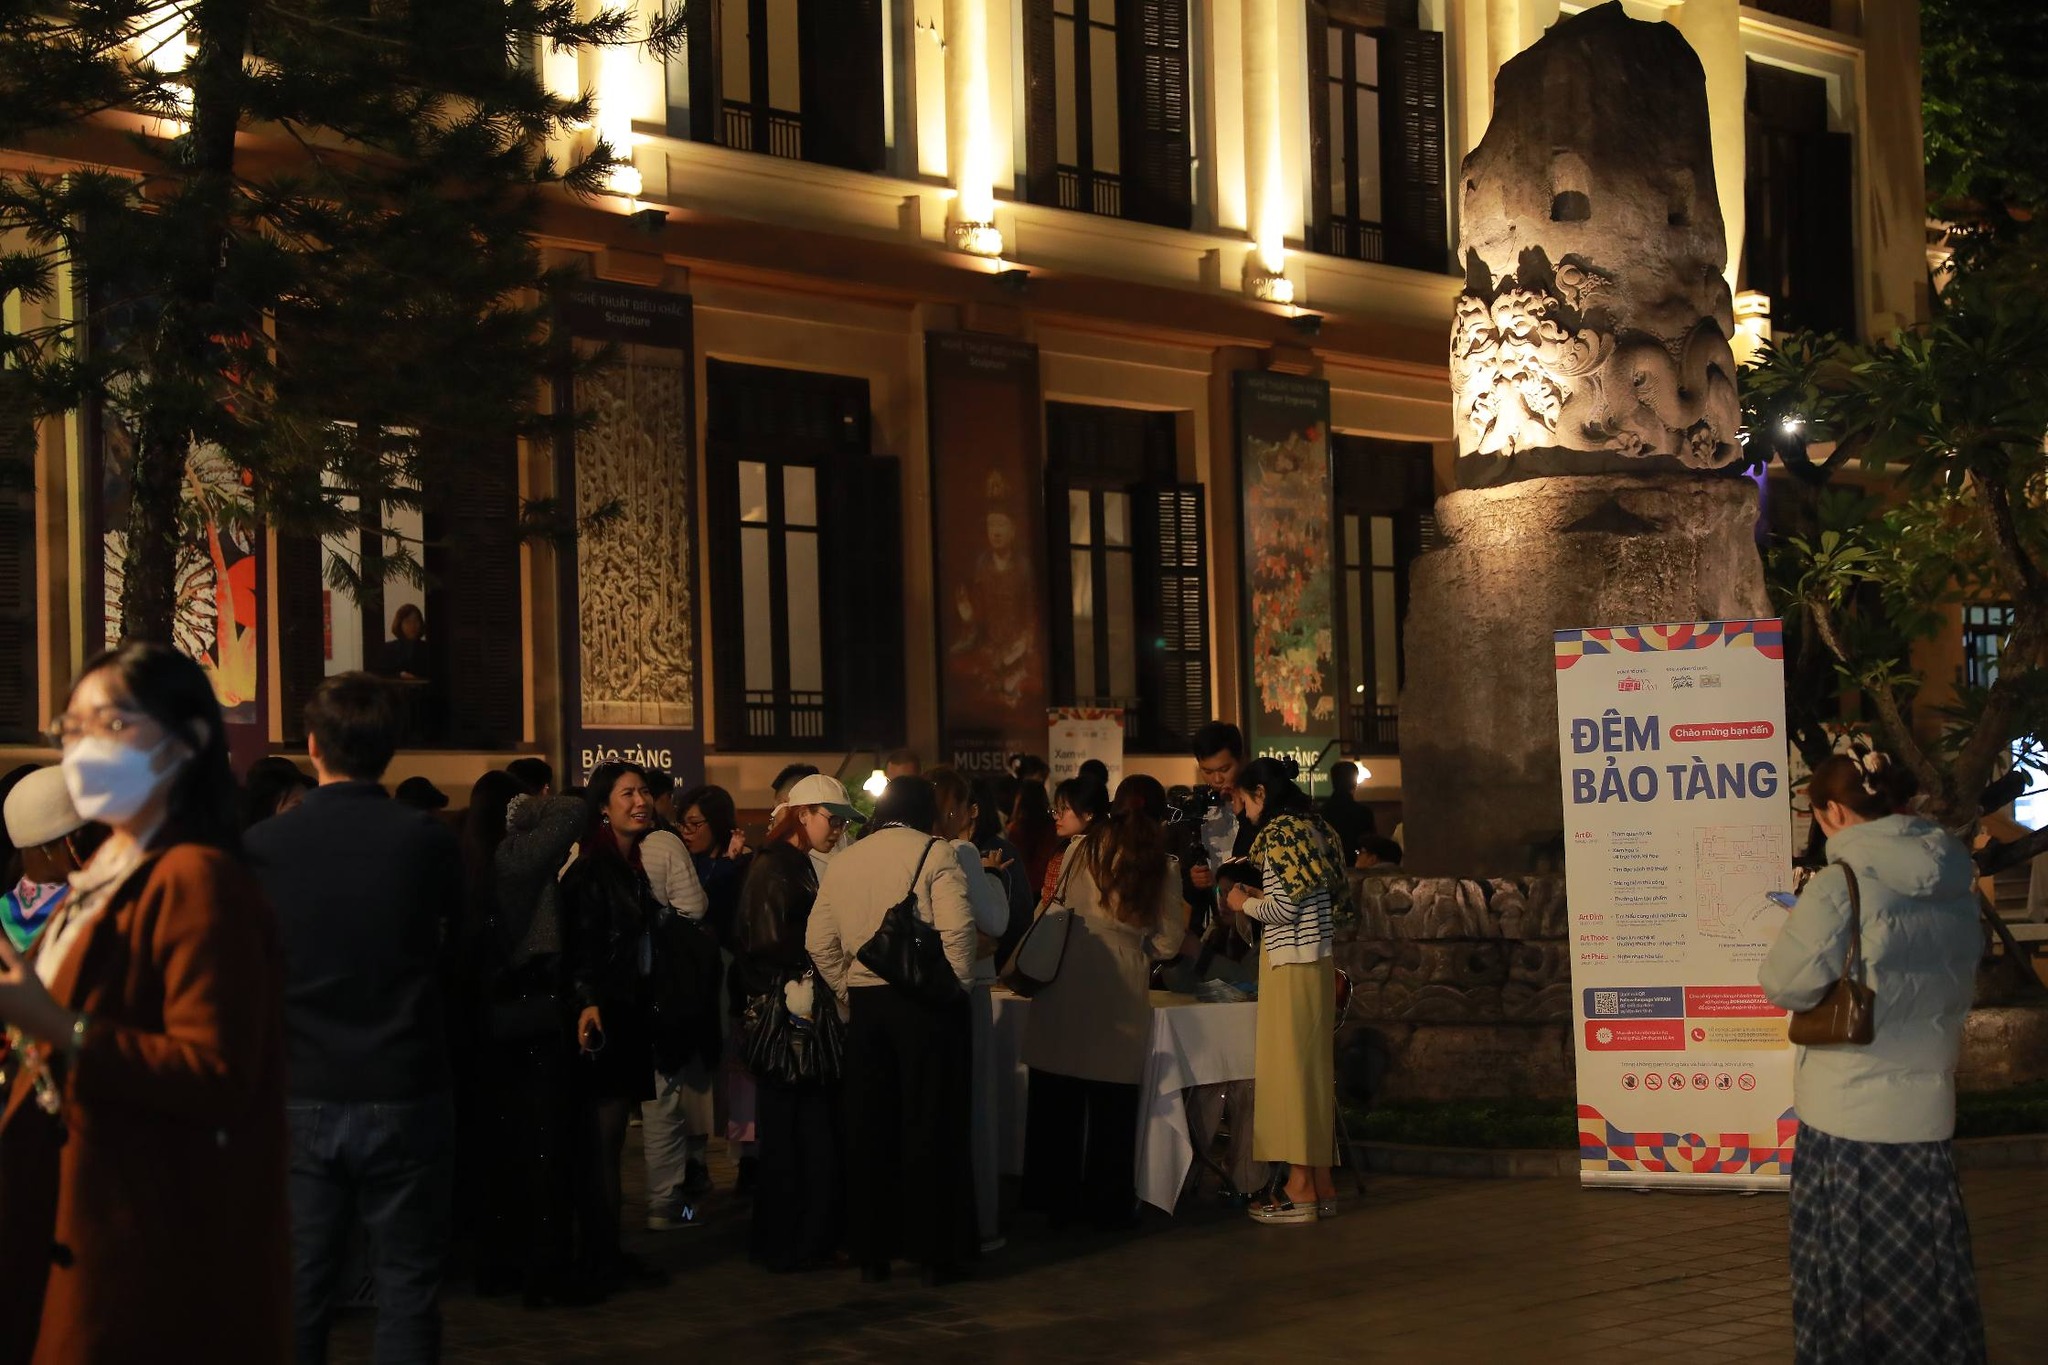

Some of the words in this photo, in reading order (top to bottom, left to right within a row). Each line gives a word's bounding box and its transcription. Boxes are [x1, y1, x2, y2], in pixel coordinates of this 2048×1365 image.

[604, 311, 650, 327] Sculpture
[1570, 708, 1660, 753] ĐÊM
[1675, 727, 1701, 737] Chào
[1701, 726, 1729, 738] mừng
[1730, 727, 1748, 737] bạn
[1750, 725, 1769, 735] đến
[581, 744, 619, 769] BẢO
[624, 743, 672, 769] TÀNG
[1572, 756, 1659, 804] BẢO
[1666, 756, 1778, 801] TÀNG
